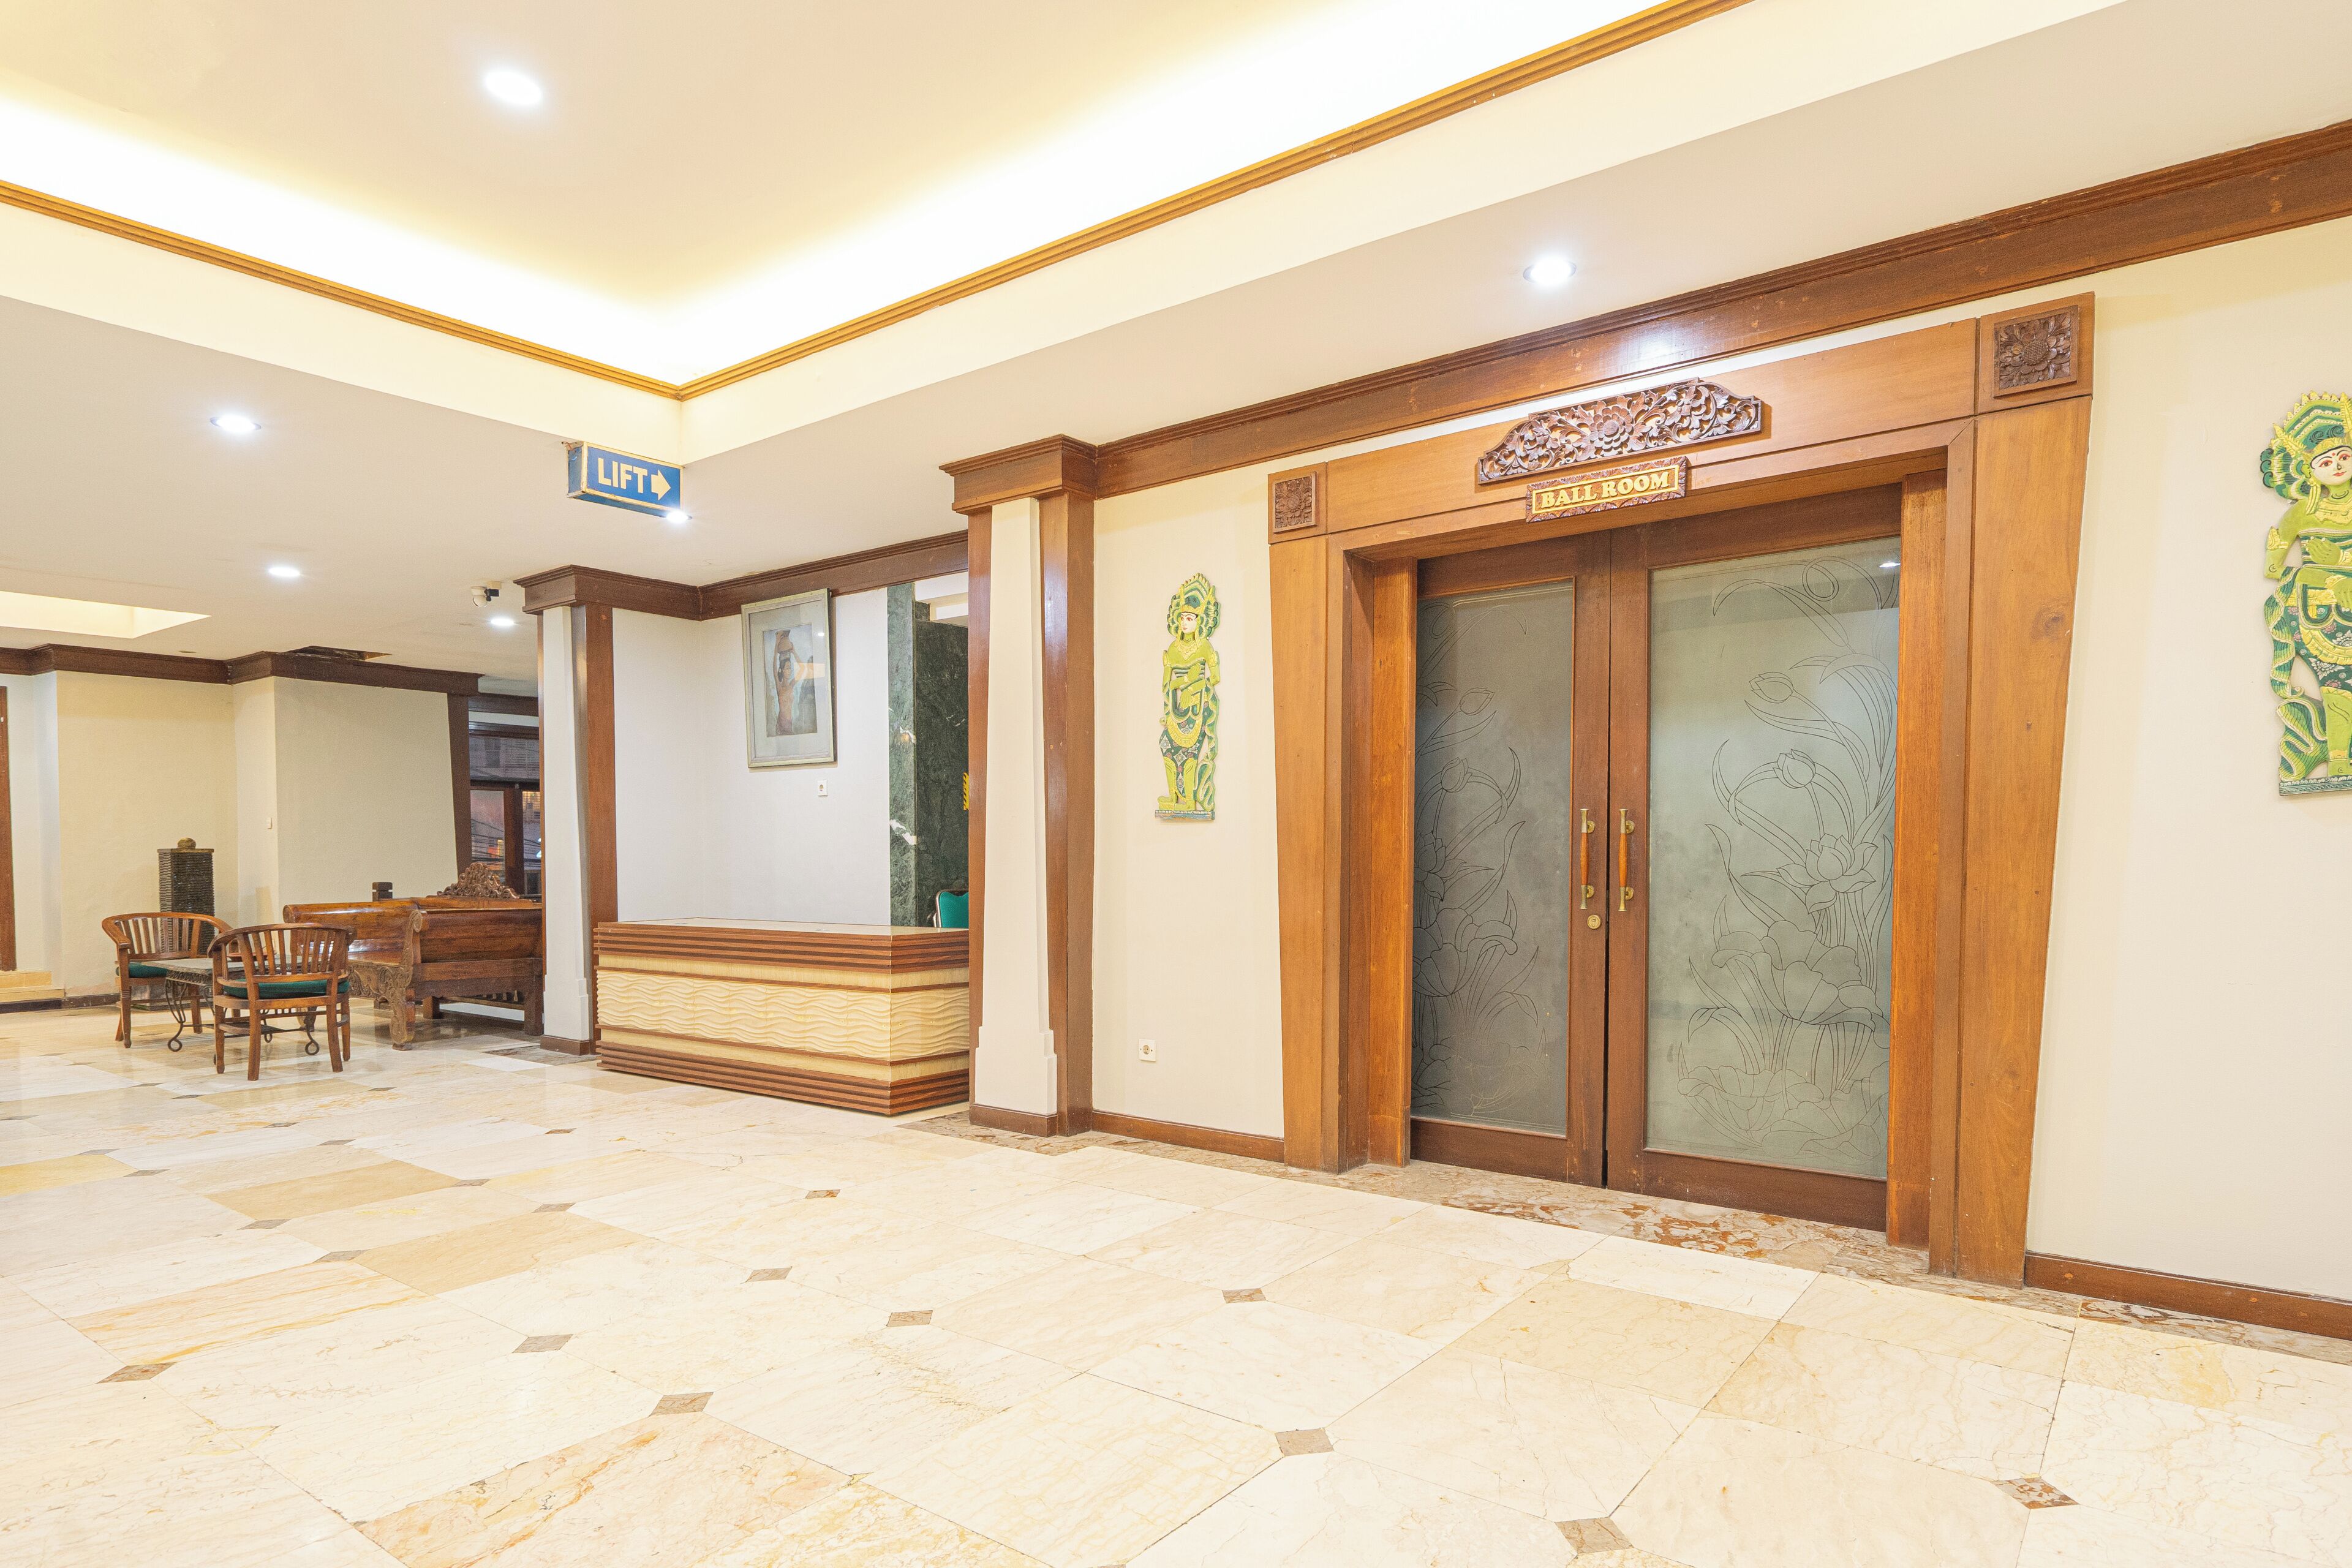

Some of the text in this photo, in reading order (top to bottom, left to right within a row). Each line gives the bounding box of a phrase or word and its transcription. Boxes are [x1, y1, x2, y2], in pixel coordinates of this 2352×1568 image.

[598, 458, 647, 494] LIFT
[1541, 471, 1670, 508] BALL ROOM
